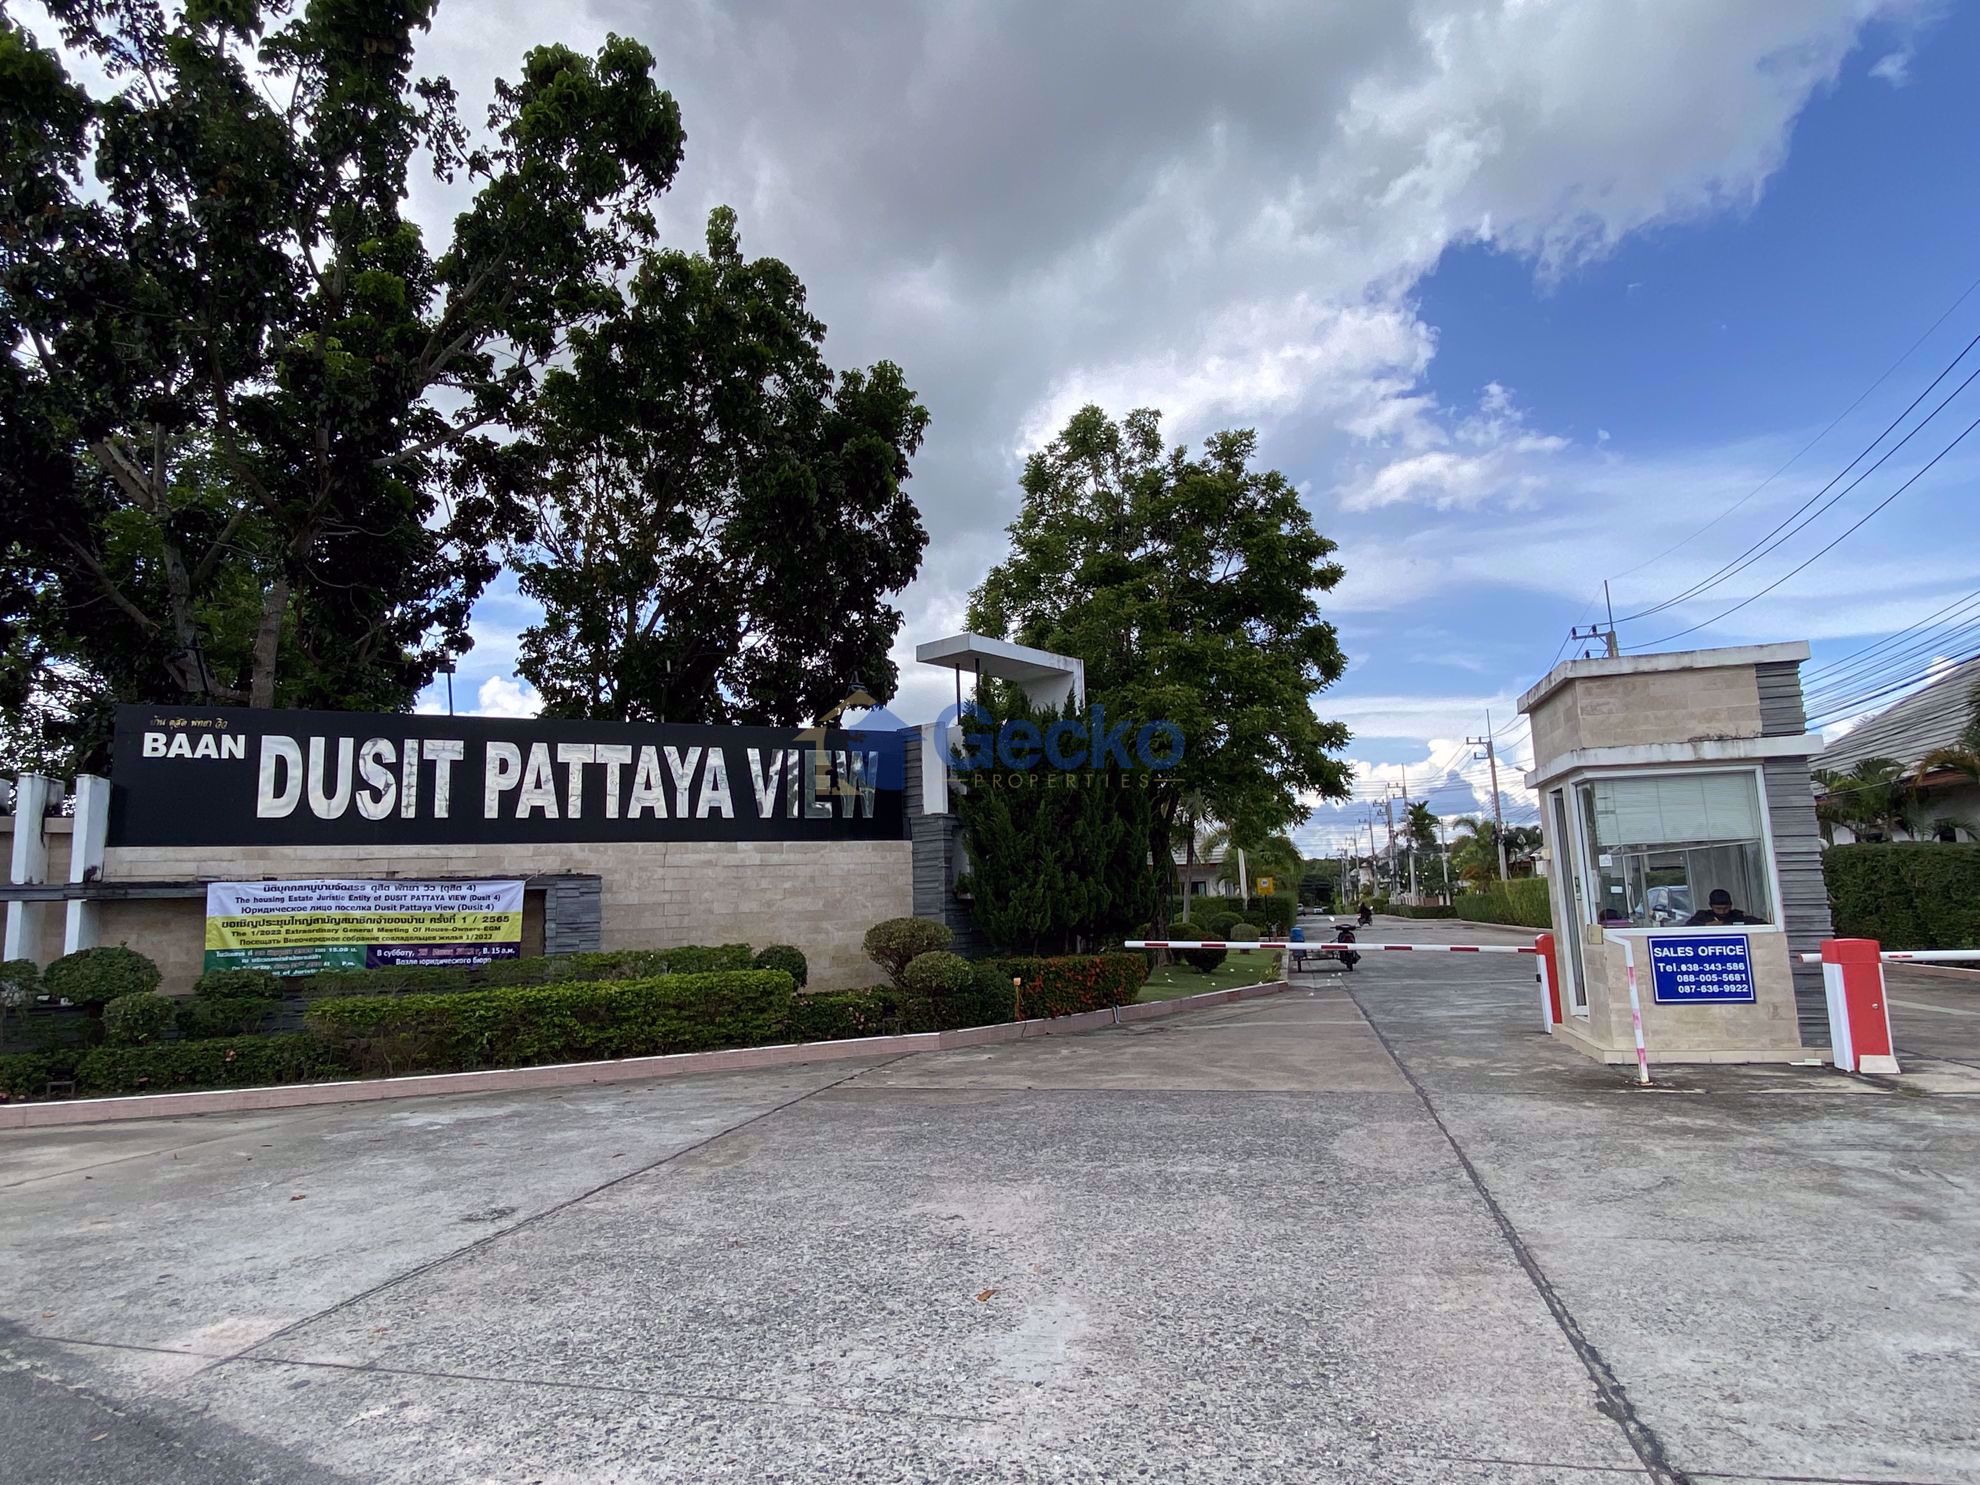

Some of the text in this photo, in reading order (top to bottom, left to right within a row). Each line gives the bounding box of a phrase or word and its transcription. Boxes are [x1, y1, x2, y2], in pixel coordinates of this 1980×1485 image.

[142, 732, 879, 821] BAAN DUSIT PATTAYA VIEW
[466, 884, 476, 892] 4)
[253, 896, 285, 904] housing
[288, 895, 314, 903] Estate
[317, 894, 345, 902] Juristic
[348, 894, 371, 903] Entity
[384, 894, 408, 902] DUSIT
[410, 894, 445, 902] PATTAYA
[469, 894, 491, 902] (Dusit
[493, 894, 501, 902] 4)
[241, 905, 308, 915] Юридическое
[309, 905, 333, 913] лицо
[334, 904, 372, 912] поселка
[400, 904, 432, 912] Pattaya
[457, 904, 483, 912] (Dusit
[485, 904, 495, 912] 4)
[240, 938, 281, 946] Посещать
[1653, 945, 1745, 957] SALES OFFICE
[1676, 974, 1746, 982] 088-005-5681
[1678, 984, 1749, 993] 087-636-9922
